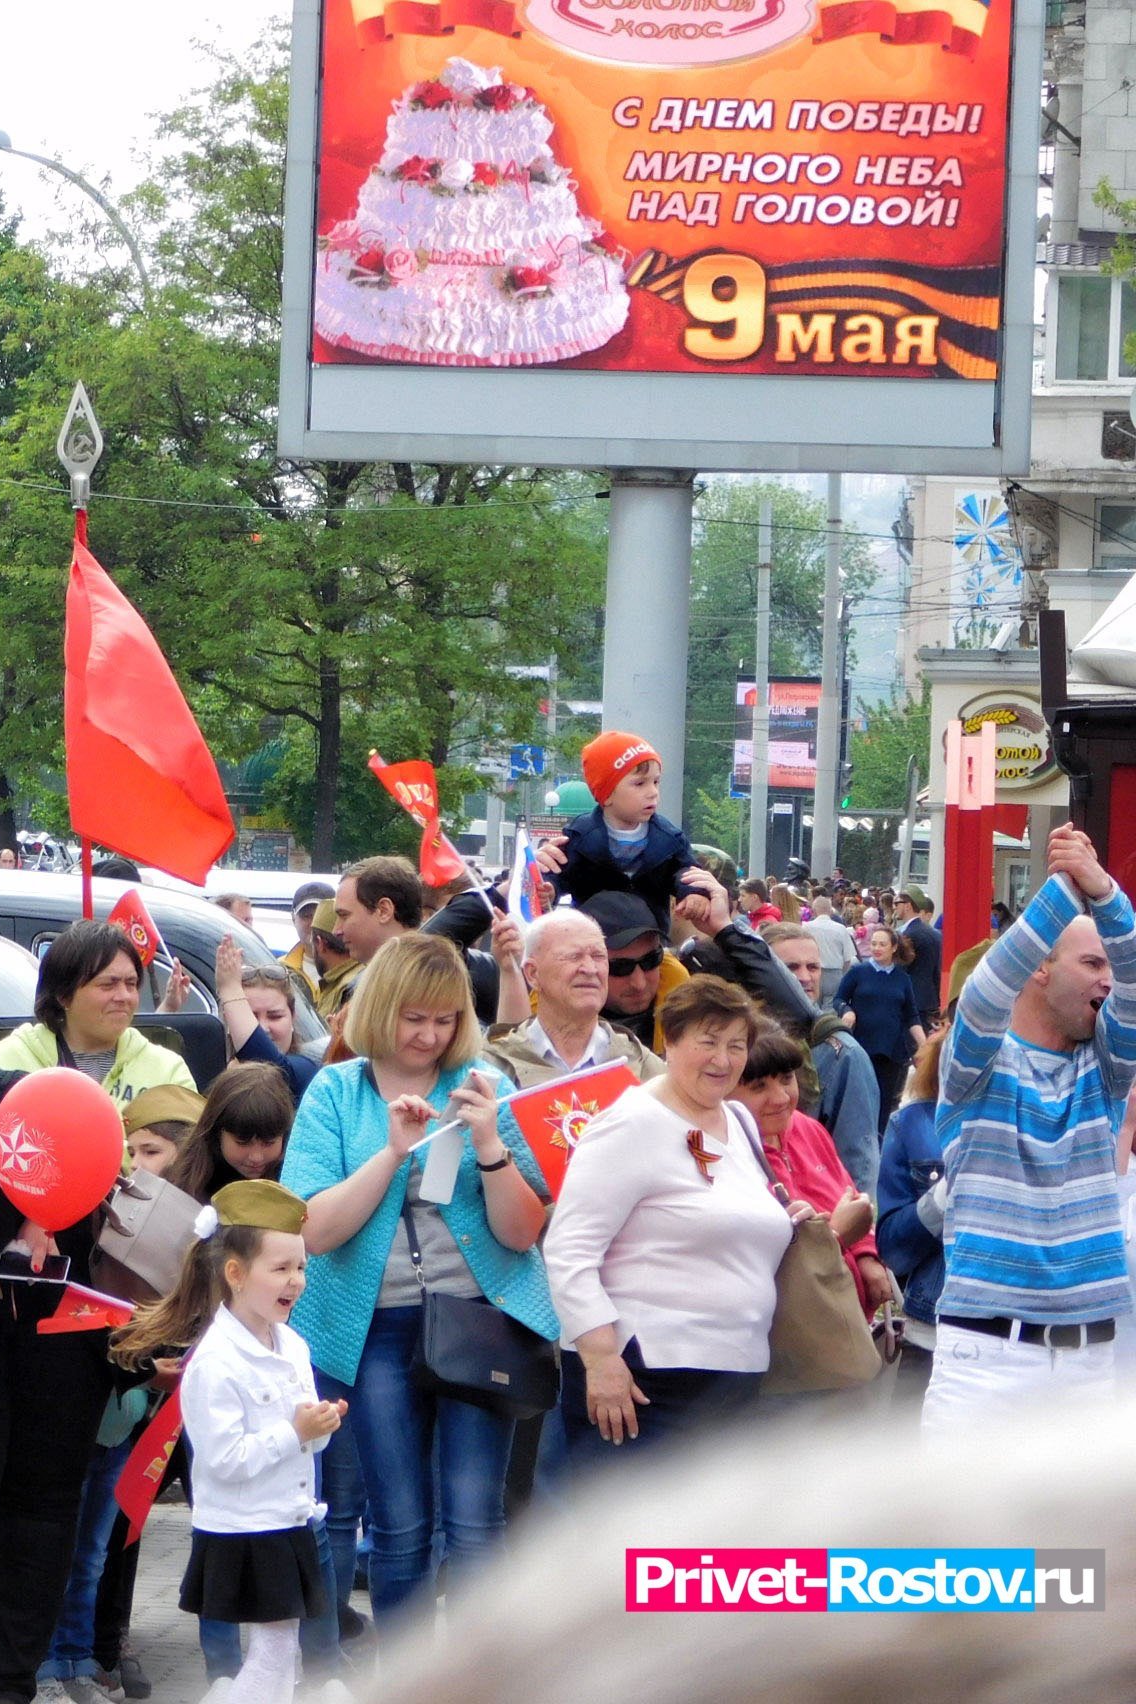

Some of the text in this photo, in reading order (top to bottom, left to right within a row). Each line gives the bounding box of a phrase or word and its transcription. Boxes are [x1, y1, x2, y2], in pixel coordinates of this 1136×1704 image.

[614, 96, 984, 137] С ДНЕМ ПОБЕДЫ!
[625, 151, 963, 187] МИРНОГО НЕБА
[628, 189, 961, 227] НАД ГОЛОВОЙ!
[683, 253, 940, 366] 9 мая
